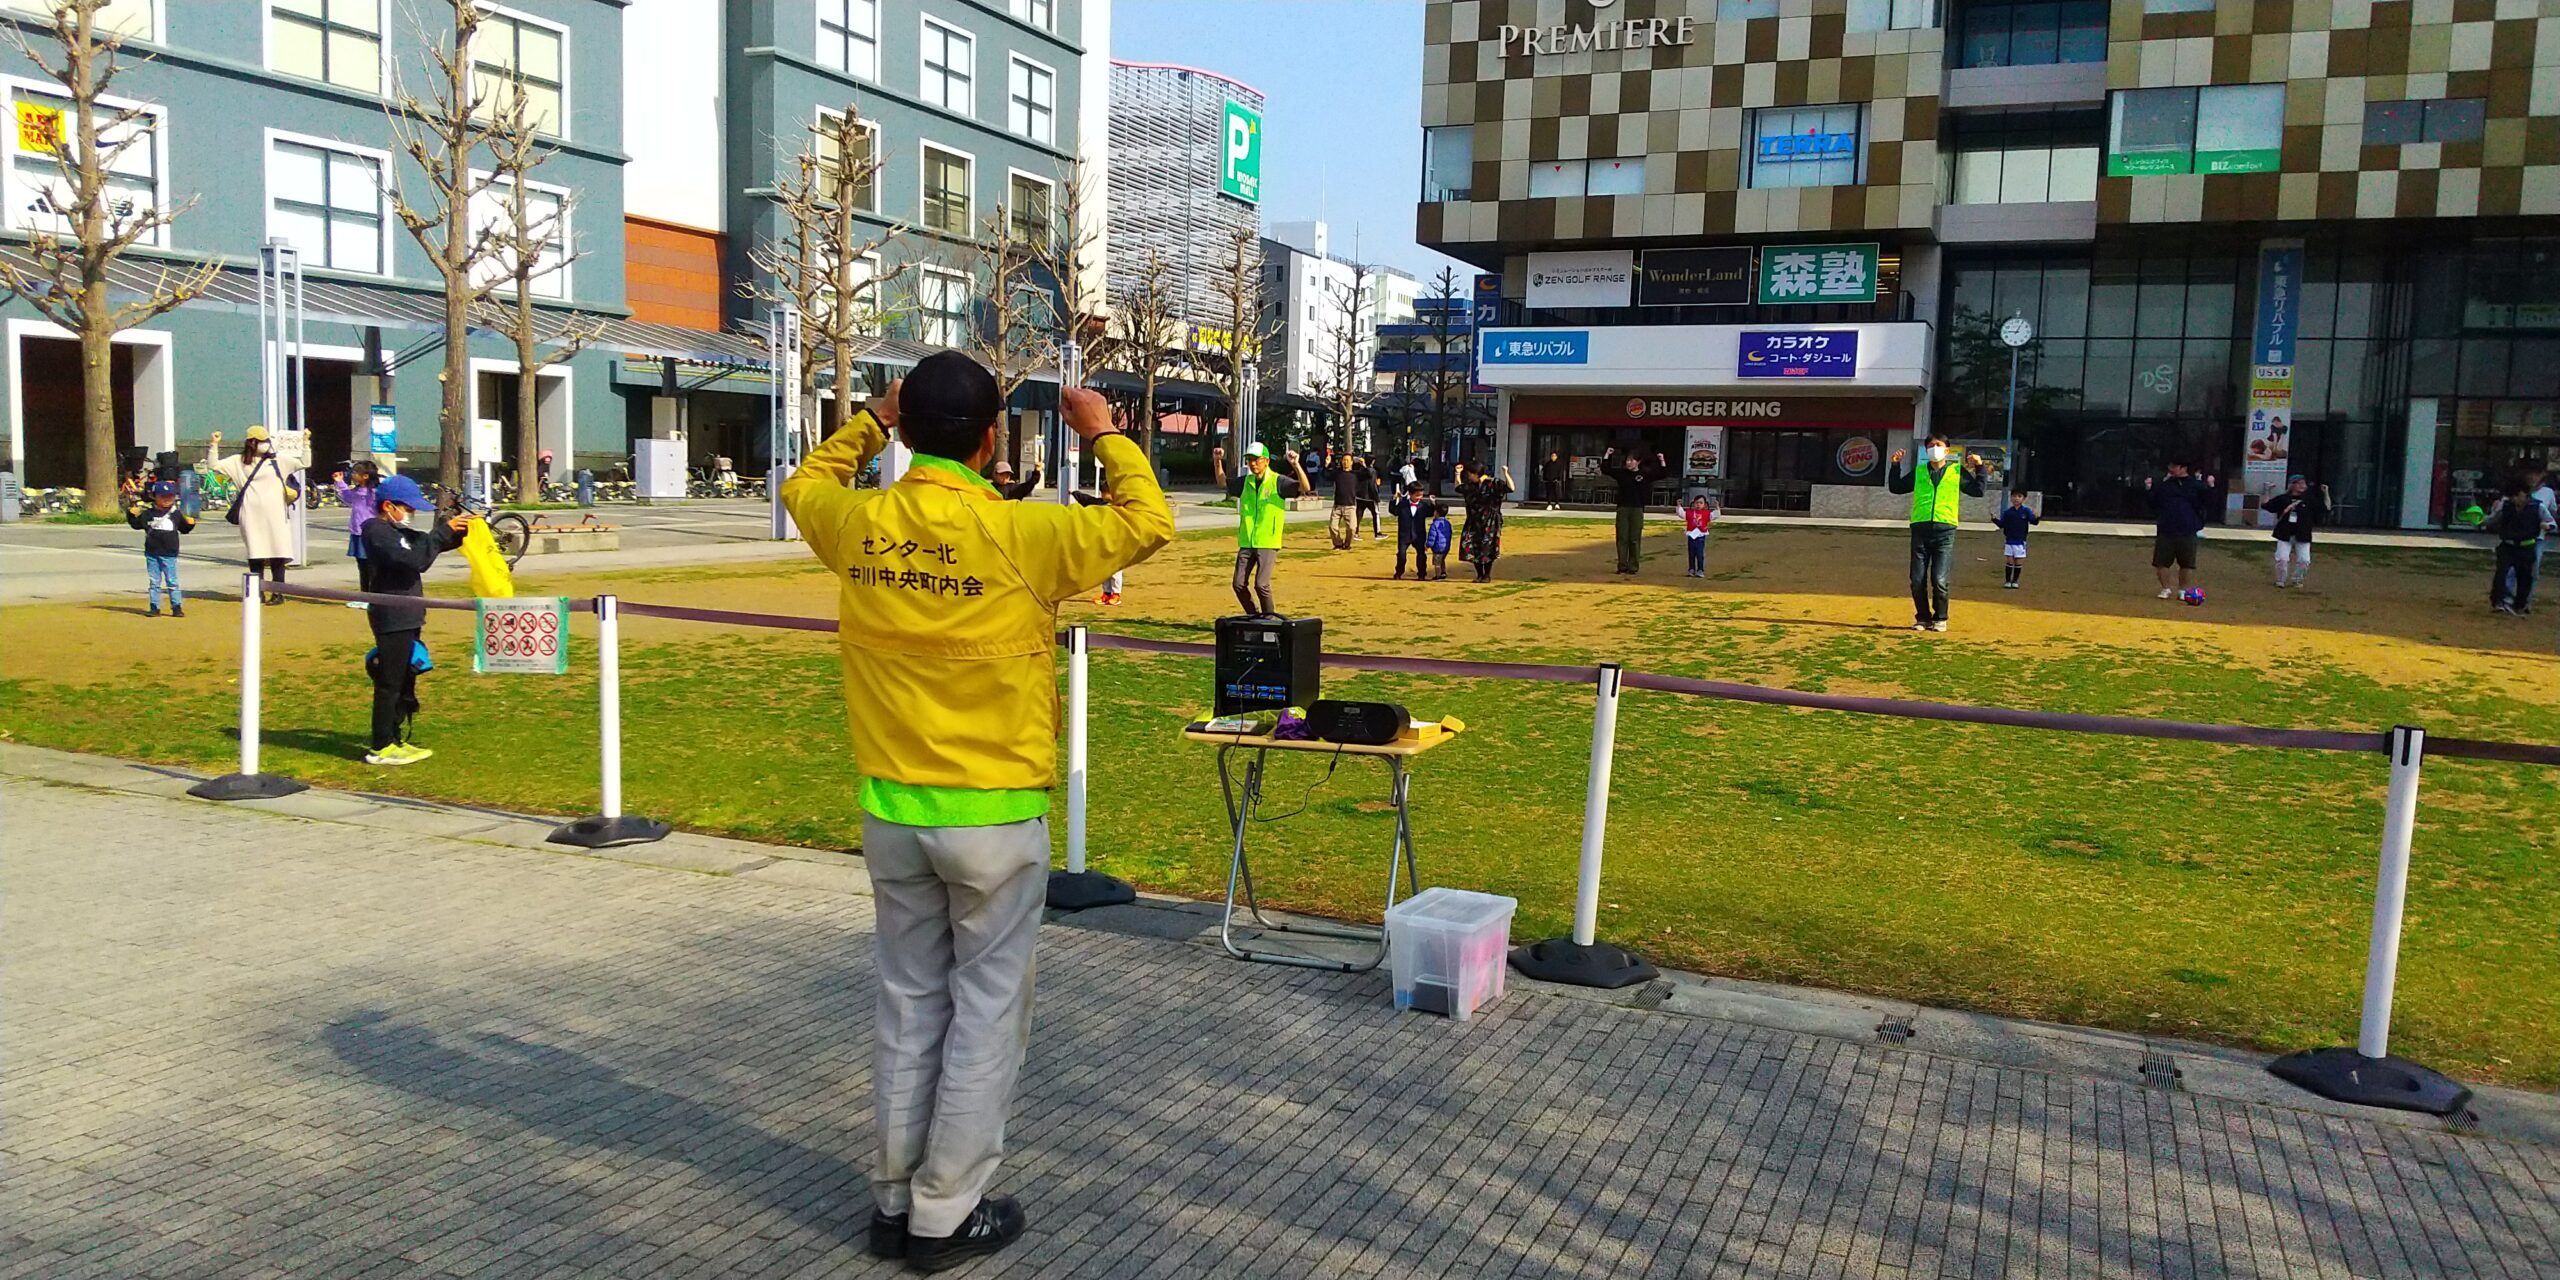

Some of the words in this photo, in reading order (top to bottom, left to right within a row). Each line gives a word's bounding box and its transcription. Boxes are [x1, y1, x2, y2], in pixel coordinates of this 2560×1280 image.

[1497, 16, 1695, 58] PREMIERE
[1227, 112, 1250, 179] P
[1759, 133, 1853, 156] TERRA
[1545, 276, 1564, 285] ZEN
[1566, 275, 1591, 284] GOLF
[1593, 273, 1626, 283] RANGE
[1649, 267, 1743, 282] WonderLand
[1770, 251, 1867, 297] 森塾
[1509, 341, 1575, 357] 東急リバブル
[1766, 335, 1830, 349] カラオケ
[1770, 353, 1852, 364] コート・ダジュール
[1650, 401, 1727, 417] BURGER
[1730, 401, 1782, 417] KING
[1844, 451, 1873, 467] KING
[861, 535, 958, 565] センター北
[848, 564, 984, 598] 中川中央町内会
